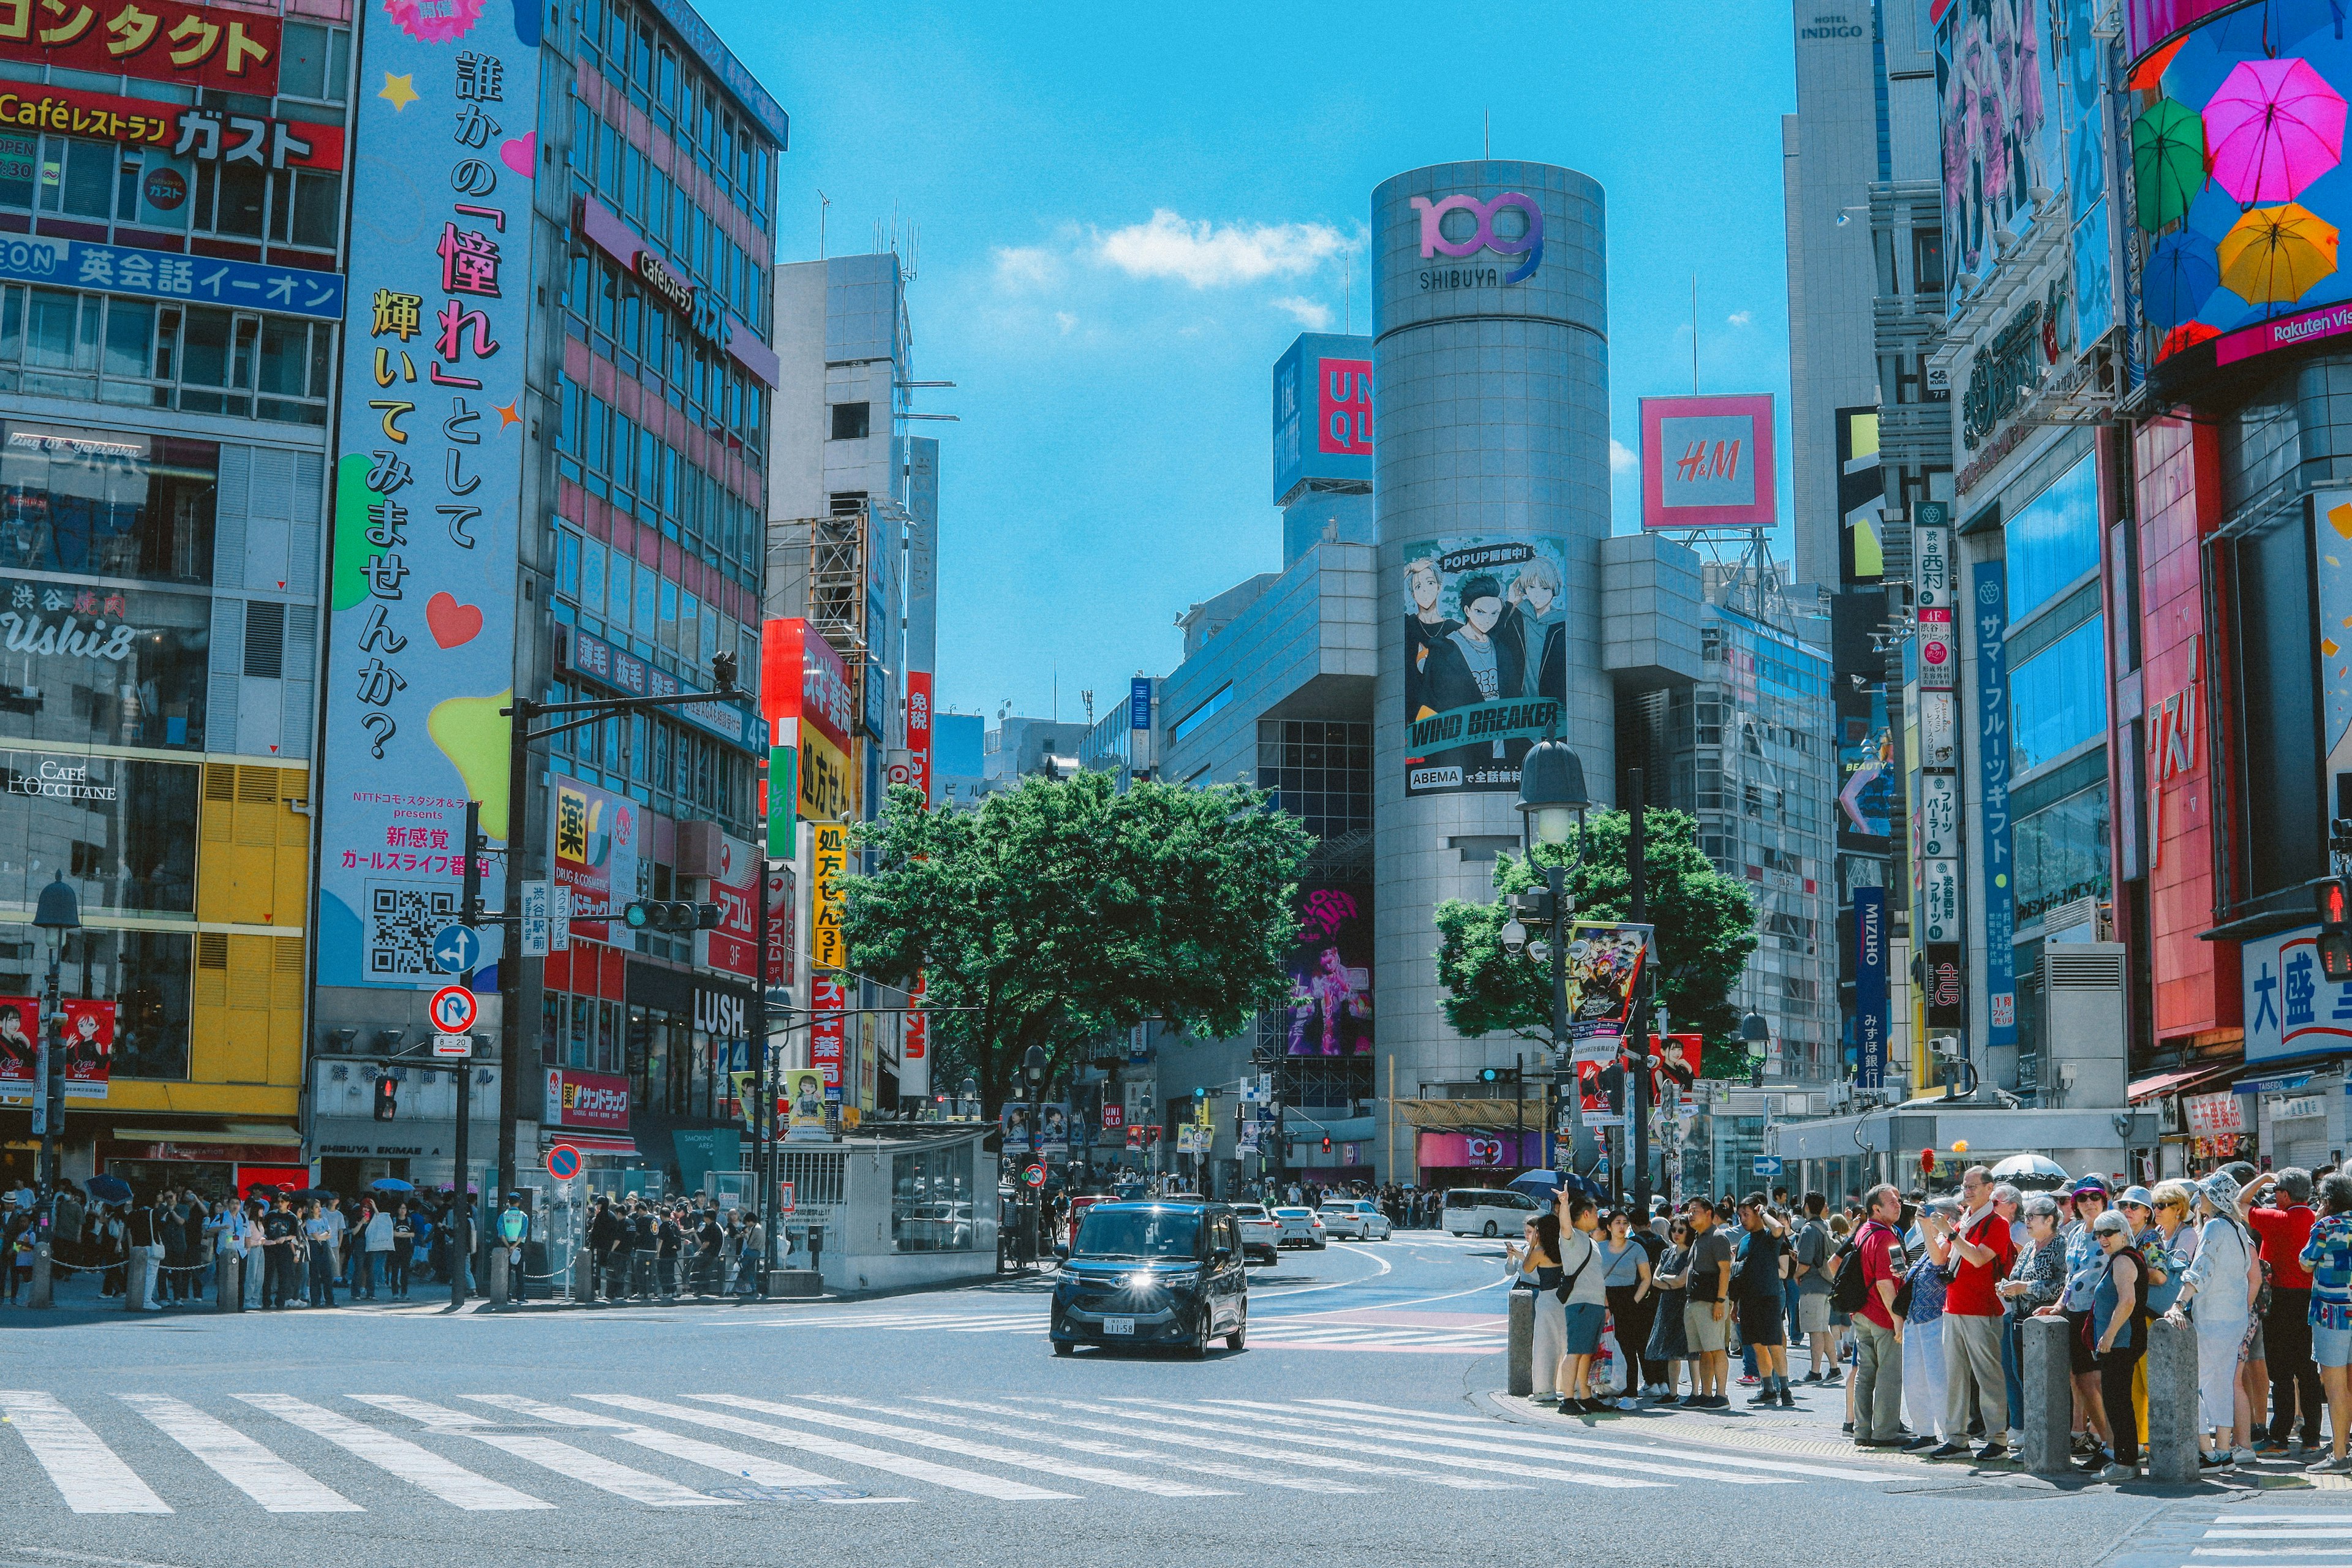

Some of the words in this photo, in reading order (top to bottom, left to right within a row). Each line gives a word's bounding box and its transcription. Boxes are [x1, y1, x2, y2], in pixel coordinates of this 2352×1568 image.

[1802, 25, 1863, 39] INDIGO
[175, 111, 310, 168] ガスト
[149, 186, 182, 199] ガスト
[1411, 192, 1544, 284] 109
[1420, 268, 1496, 290] SHIBUYA
[431, 51, 505, 549] 誰かの「憧れ」として
[692, 289, 733, 353] ガスト
[2274, 317, 2331, 344] Rakuten
[1676, 439, 1741, 483] H&M
[1923, 530, 1943, 589] 渋谷西村
[12, 586, 126, 618] 渋谷焼肉
[1927, 611, 1942, 621] 4F
[0, 612, 135, 661] Ushi8
[1921, 624, 1939, 632] 渋谷
[579, 636, 607, 676] 薄毛
[616, 655, 643, 692] 抜毛
[803, 647, 851, 739] スギ薬局
[911, 692, 928, 729] 免税
[1135, 685, 1147, 699] THE
[1135, 703, 1147, 726] PRIME
[1412, 713, 1463, 748] WIND
[1468, 701, 1558, 733] BREAKER
[747, 717, 767, 753] 4F
[1981, 615, 2008, 864] サマーフルーツギフト
[1413, 770, 1458, 785] ABEMA
[1465, 769, 1521, 783] で全話無料
[1845, 761, 1888, 772] BEAUTY
[393, 807, 443, 820] presents
[772, 783, 783, 818] レイク
[1927, 798, 1939, 839] パーラー
[1941, 792, 1952, 833] フルーツ
[386, 826, 450, 850] 新感覚
[560, 794, 584, 857] 薬
[556, 867, 573, 882] DRUG
[574, 873, 579, 884] &
[579, 873, 608, 892] COSMETIC
[1942, 876, 1954, 919] 渋谷西村
[533, 886, 545, 950] 渋谷駅前
[556, 889, 567, 948] スクランブル式
[718, 891, 752, 933] アコム
[1929, 881, 1940, 923] フルーツ
[768, 919, 782, 962] アコム
[823, 930, 836, 964] 3F
[1865, 903, 1878, 966] MIZUHO
[2003, 899, 2013, 978] 無料配送地域
[729, 945, 741, 967] 3F
[1935, 962, 1959, 1006] HUB
[1995, 995, 2013, 1008] 1階
[694, 988, 745, 1038] LUSH
[814, 981, 840, 1084] スギ薬局
[1864, 1014, 1878, 1088] みずほ銀行
[564, 1085, 573, 1107] 薬
[582, 1087, 627, 1112] サンドラッグ
[2258, 1080, 2284, 1091] TAISEIDO
[1105, 1116, 1121, 1125] QLO
[1106, 1107, 1120, 1116] UNI
[2190, 1099, 2241, 1131] 三千里薬品
[320, 1145, 370, 1154] SHIBUYA
[377, 1146, 423, 1155] EKIMAE
[1466, 1139, 1502, 1165] 109
[1112, 1324, 1133, 1333] 11-58
